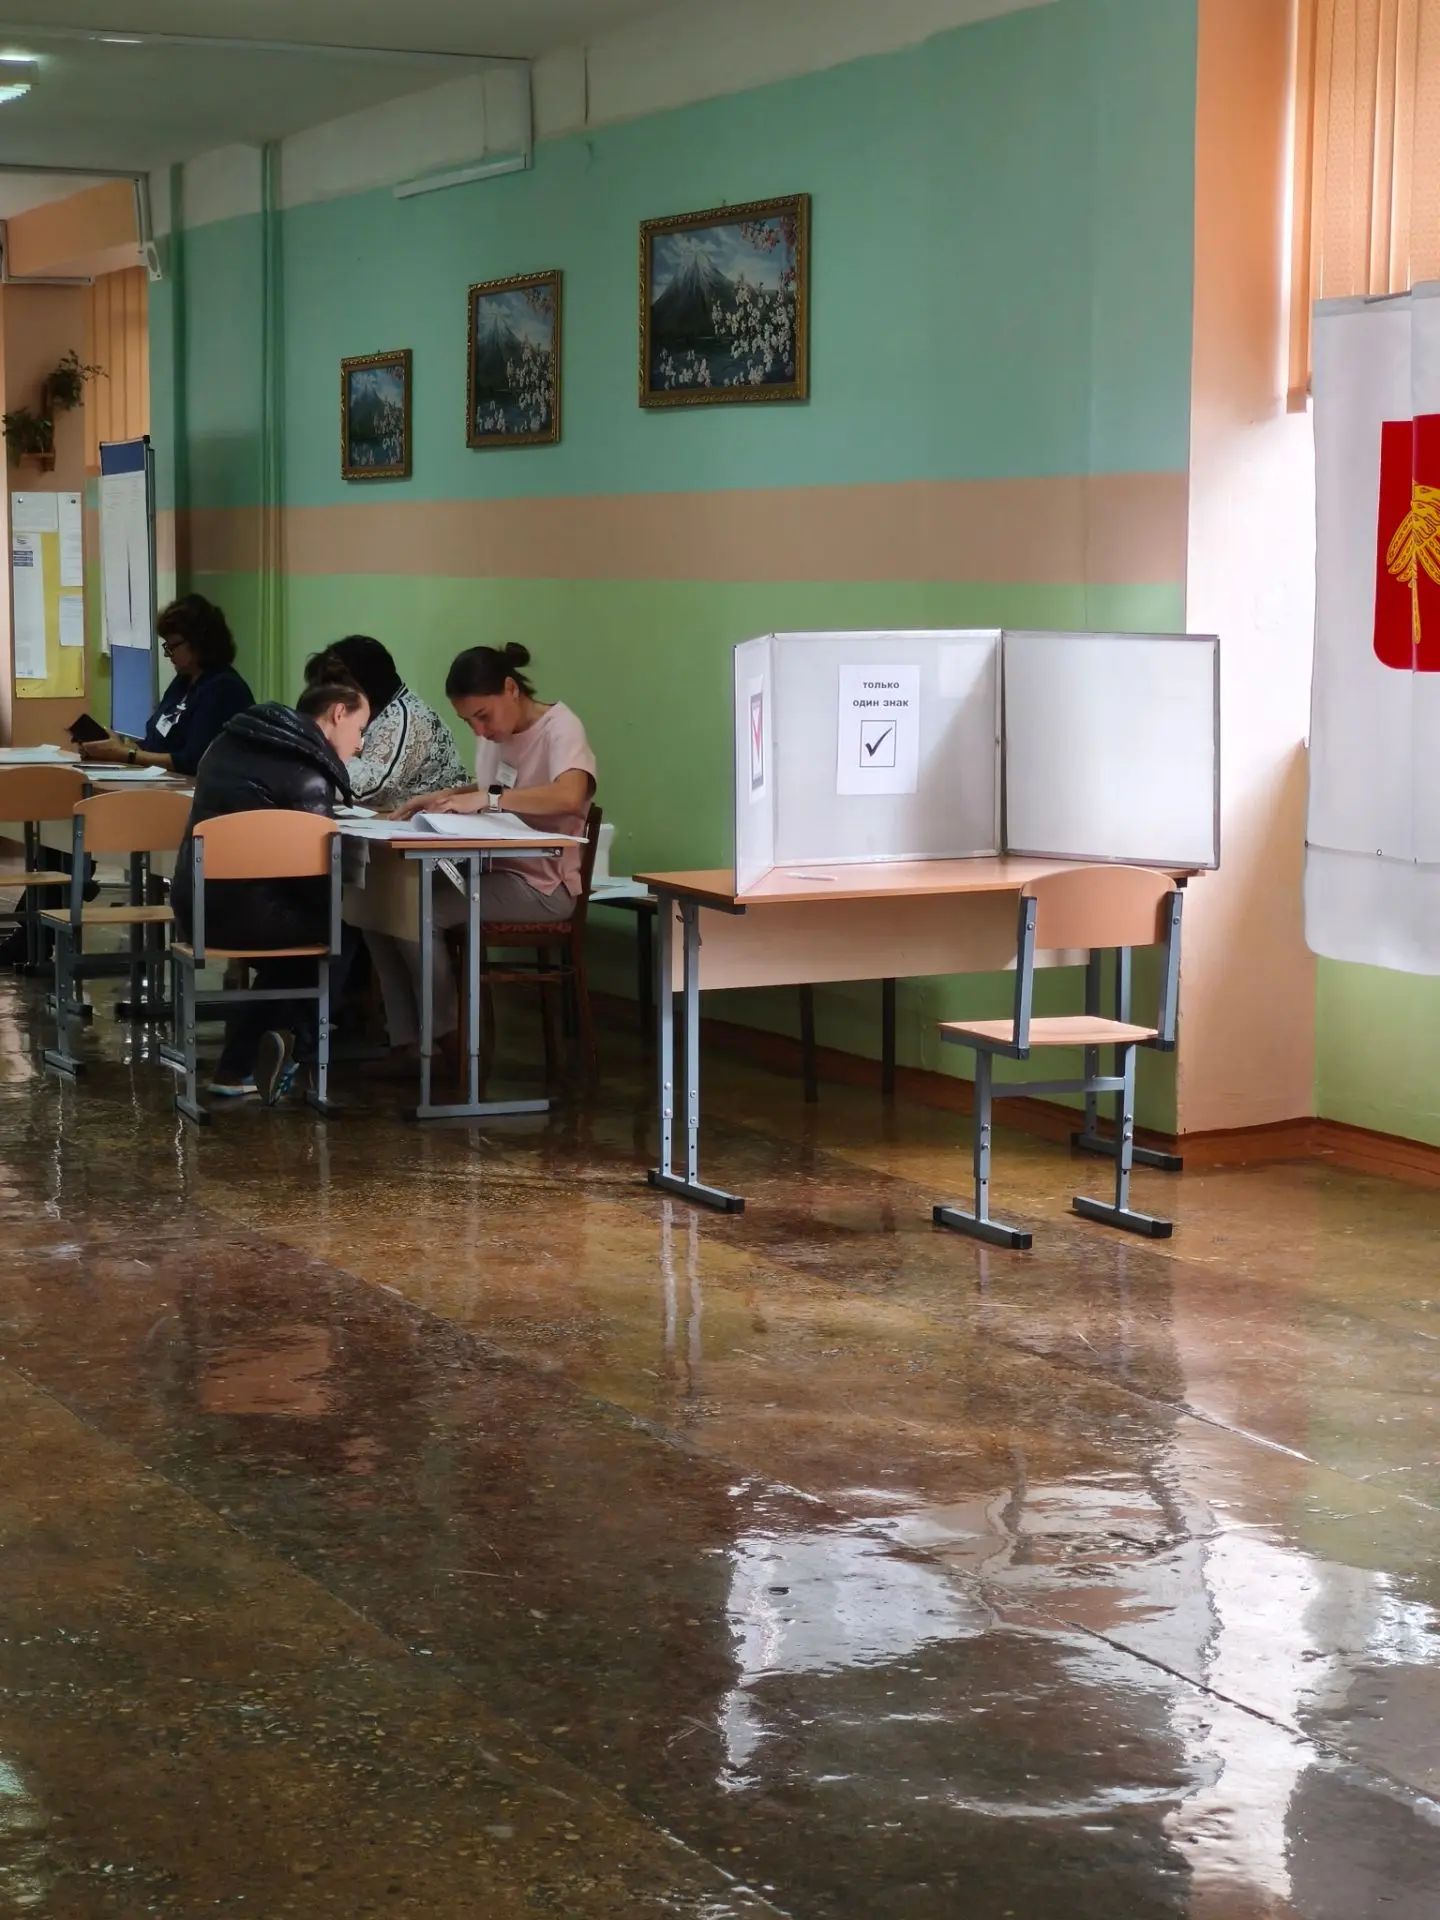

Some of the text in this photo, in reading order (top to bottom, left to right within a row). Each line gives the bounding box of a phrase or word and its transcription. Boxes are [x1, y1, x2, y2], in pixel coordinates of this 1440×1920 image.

[863, 681, 900, 689] только
[852, 699, 909, 708] один знак
